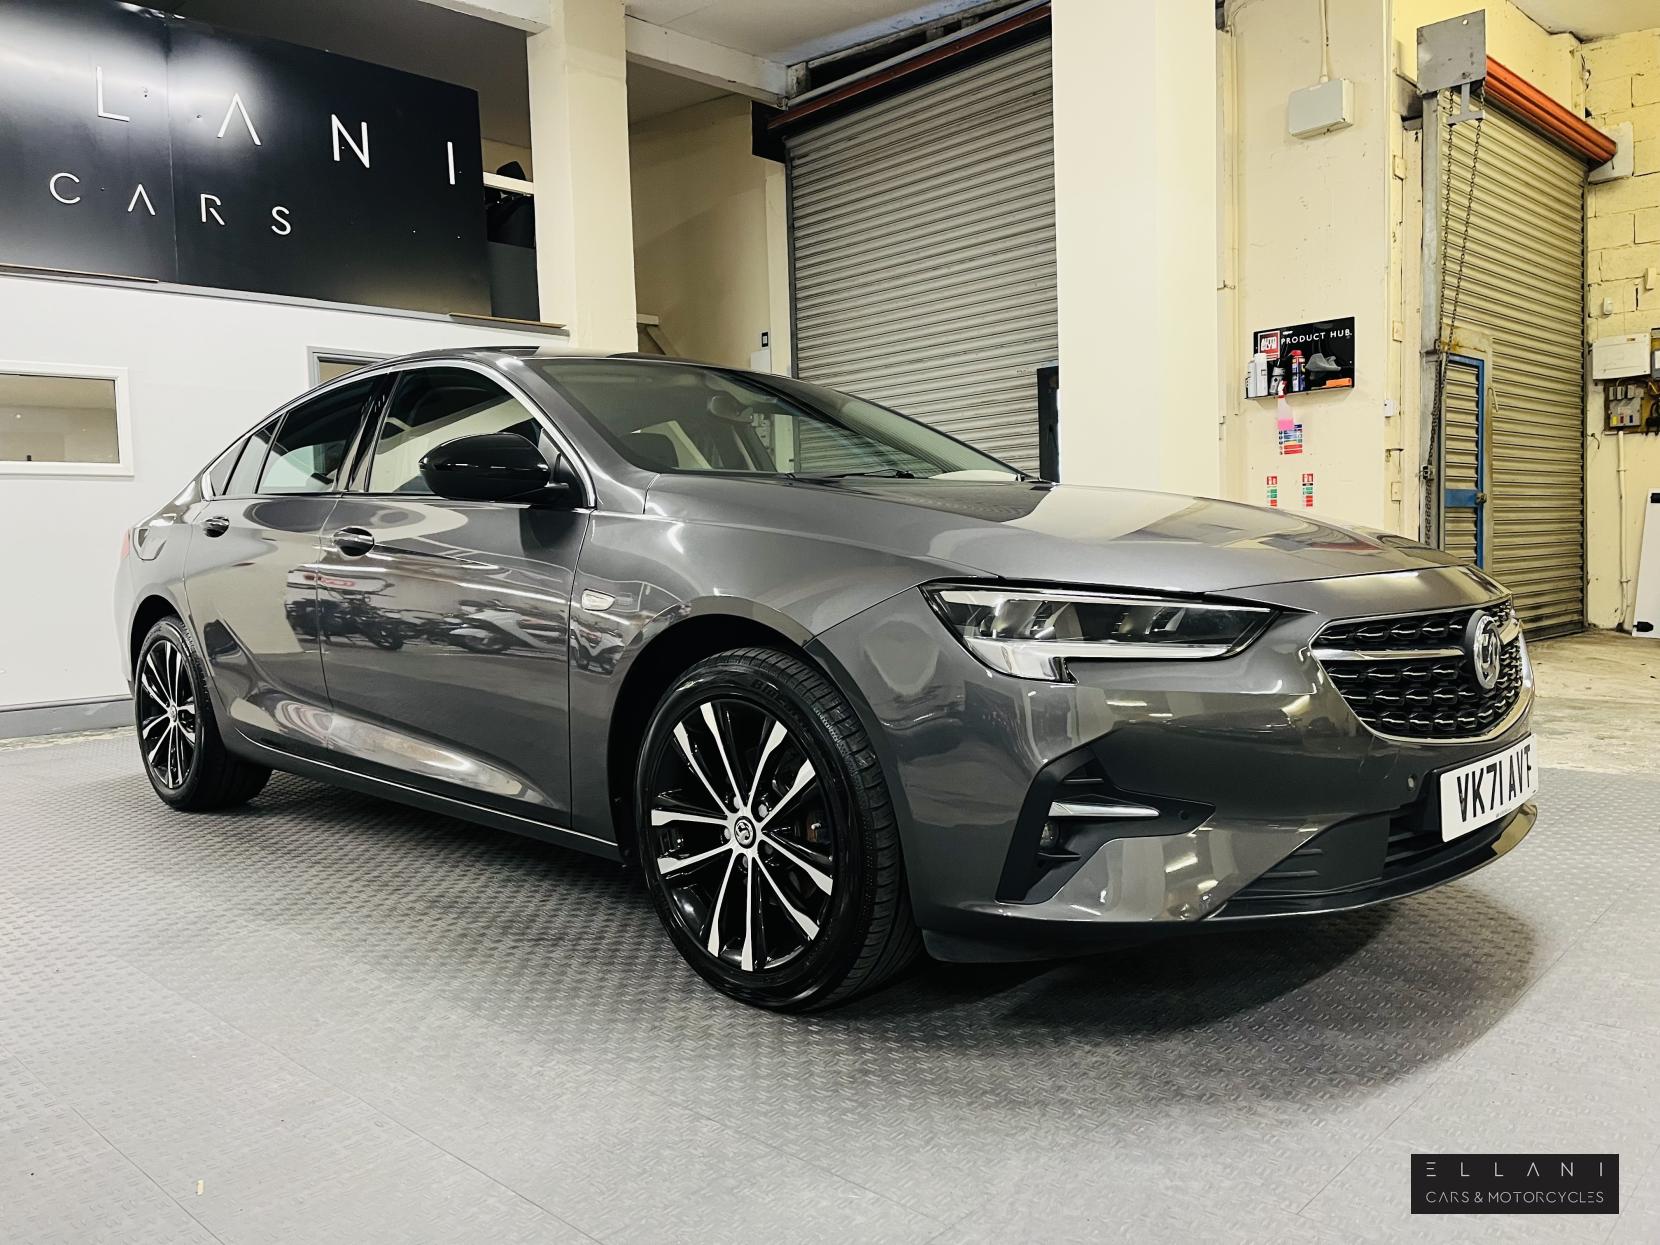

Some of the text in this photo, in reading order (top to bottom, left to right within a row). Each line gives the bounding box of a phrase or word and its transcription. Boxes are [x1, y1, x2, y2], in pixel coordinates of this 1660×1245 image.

[49, 172, 292, 236] CARS
[1280, 332, 1326, 345] PRODUCT
[1456, 760, 1504, 823] VK71
